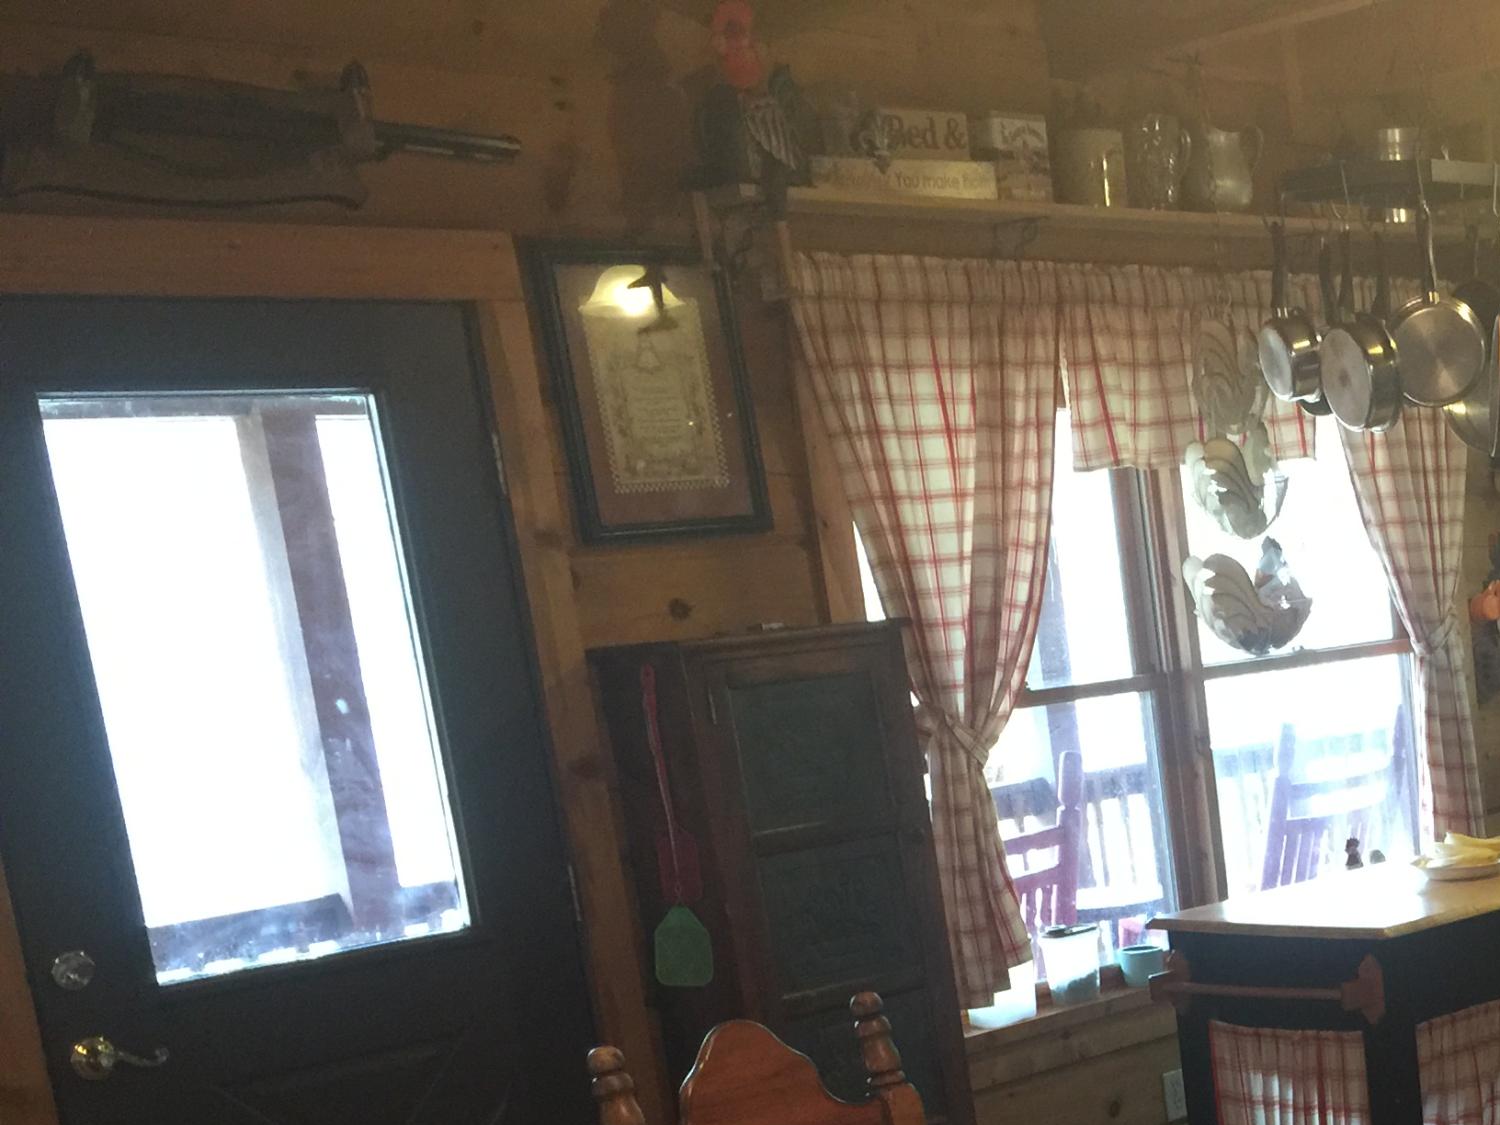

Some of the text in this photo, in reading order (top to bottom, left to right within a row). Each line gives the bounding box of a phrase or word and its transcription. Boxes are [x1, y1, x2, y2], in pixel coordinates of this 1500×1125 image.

[943, 117, 967, 151] &
[895, 170, 920, 191] You
[921, 172, 960, 192] make
